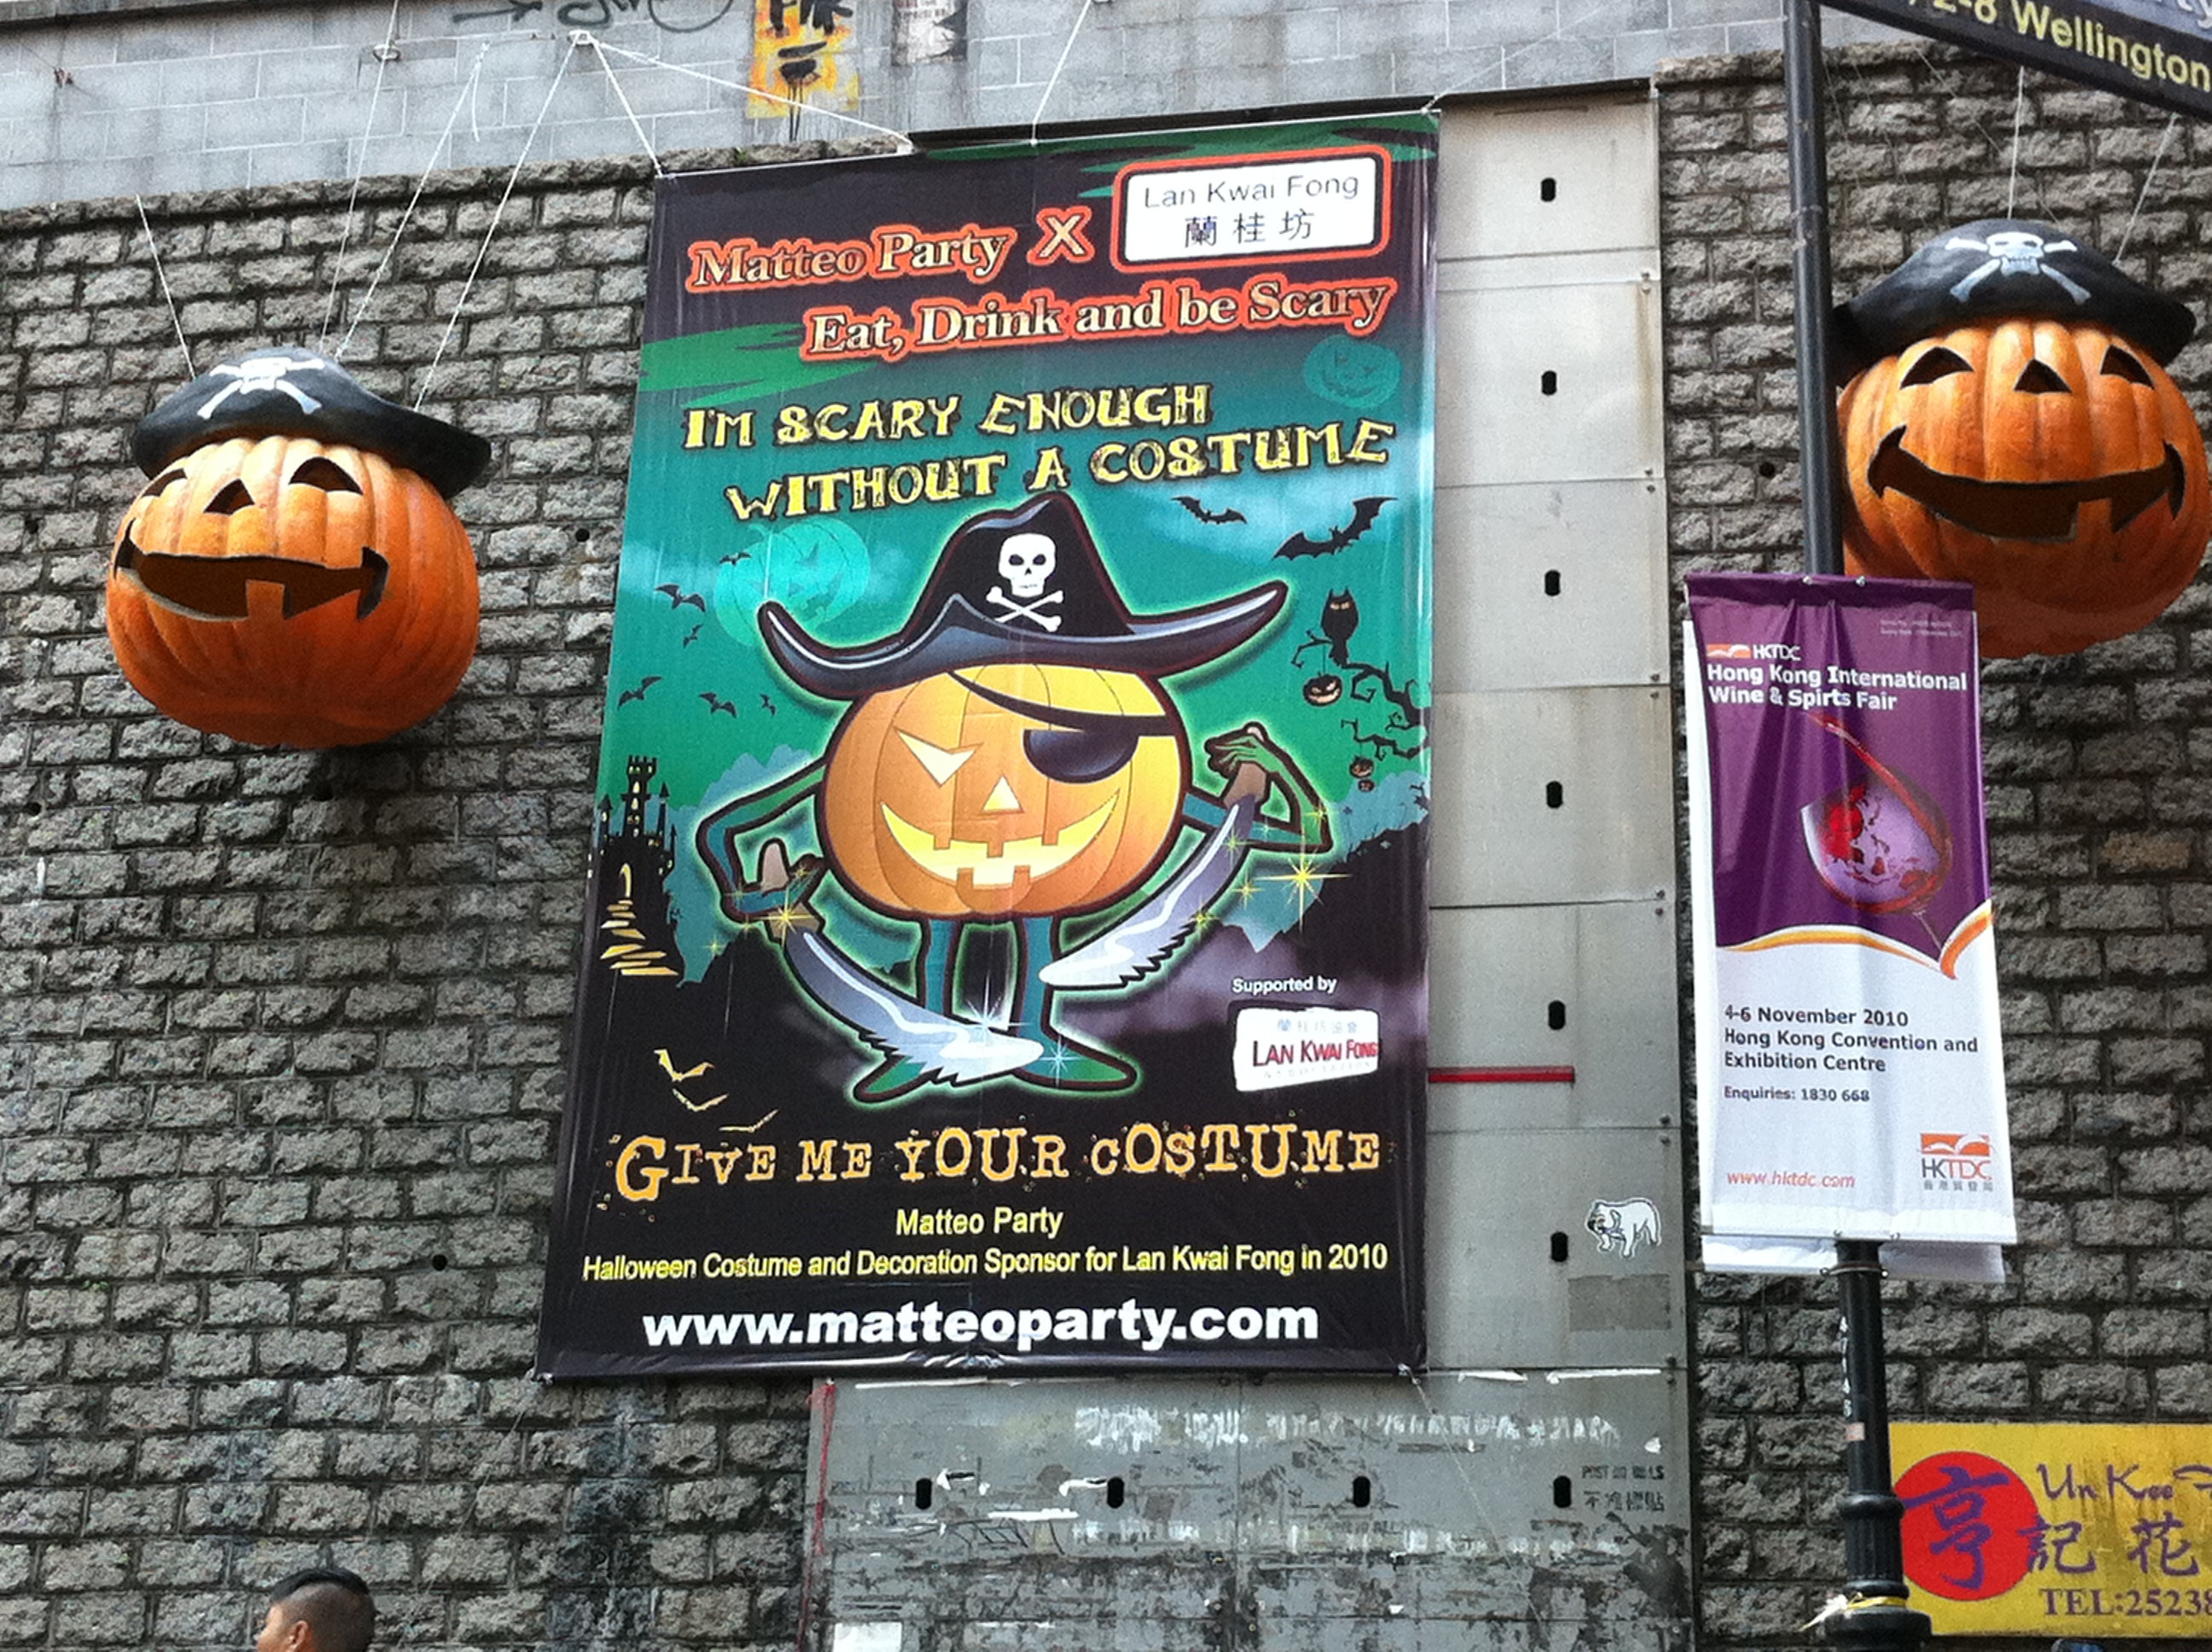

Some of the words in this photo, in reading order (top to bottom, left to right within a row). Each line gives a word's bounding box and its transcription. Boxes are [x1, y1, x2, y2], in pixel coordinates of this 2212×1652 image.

[2011, 0, 2211, 92] Wellington
[1144, 187, 1195, 209] Lan
[1207, 180, 1275, 204] Kwai
[1287, 174, 1359, 199] Fong
[1184, 207, 1315, 248] 蘭桂坊
[690, 242, 867, 288] Matteo
[875, 228, 1011, 278] Party
[809, 310, 905, 355] Eat,
[915, 297, 1062, 347] Drink
[1074, 288, 1163, 334] and
[1175, 286, 1238, 326] be
[1247, 280, 1391, 329] Scary
[683, 408, 755, 449] I'M
[775, 394, 960, 445] SCARY
[978, 384, 1211, 434] ENOUGH
[725, 452, 1007, 520] WITHOUT
[1027, 447, 1068, 492] A
[1089, 418, 1396, 484] COSTUME
[1752, 644, 1802, 661] HKTDC
[1707, 664, 1764, 685] Hong
[1769, 665, 1822, 687] Kong
[1826, 666, 1968, 691] International
[1708, 685, 1764, 704] Wine
[1769, 687, 1784, 706] &
[1855, 690, 1898, 711] Fair
[1231, 975, 1313, 995] Supported
[1317, 974, 1337, 994] by
[1724, 1003, 1752, 1023] 4-6
[1757, 1007, 1857, 1025] November
[1863, 1009, 1909, 1027] 2010
[1252, 1039, 1294, 1067] LAN
[1300, 1039, 1342, 1063] KWAI
[1724, 1027, 1771, 1049] Hong
[1777, 1029, 1826, 1050] Kong
[1831, 1031, 1938, 1051] Convention
[1943, 1036, 1979, 1053] and
[1724, 1050, 1818, 1070] Exhibition
[1823, 1054, 1887, 1073] Centre
[1723, 1085, 1796, 1102] Enquiries:
[1801, 1087, 1837, 1102] 1830
[1842, 1088, 1870, 1102] 668
[614, 1134, 777, 1201] GIVE
[795, 1139, 873, 1183] ME
[894, 1126, 1069, 1183] YOUR
[1090, 1122, 1381, 1178] COSTUME
[1921, 1158, 1992, 1182] HKTDC
[1726, 1170, 1856, 1190] www.hktdc.com
[894, 1207, 985, 1236] Matteo
[992, 1205, 1064, 1239] Party
[582, 1254, 696, 1281] Halloween
[702, 1252, 802, 1278] Costume
[807, 1249, 852, 1277] and
[856, 1248, 978, 1276] Decoration
[983, 1247, 1081, 1278] Sponsor
[1085, 1245, 1117, 1272] for
[1122, 1245, 1166, 1271] Lan
[1171, 1243, 1229, 1271] Kwai
[1235, 1243, 1295, 1276] Fong
[1301, 1243, 1323, 1271] in
[1327, 1242, 1389, 1270] 2010
[642, 1297, 1319, 1352] www.matteoparty.com
[2036, 1463, 2097, 1500] Un
[2106, 1463, 2174, 1500] Kee
